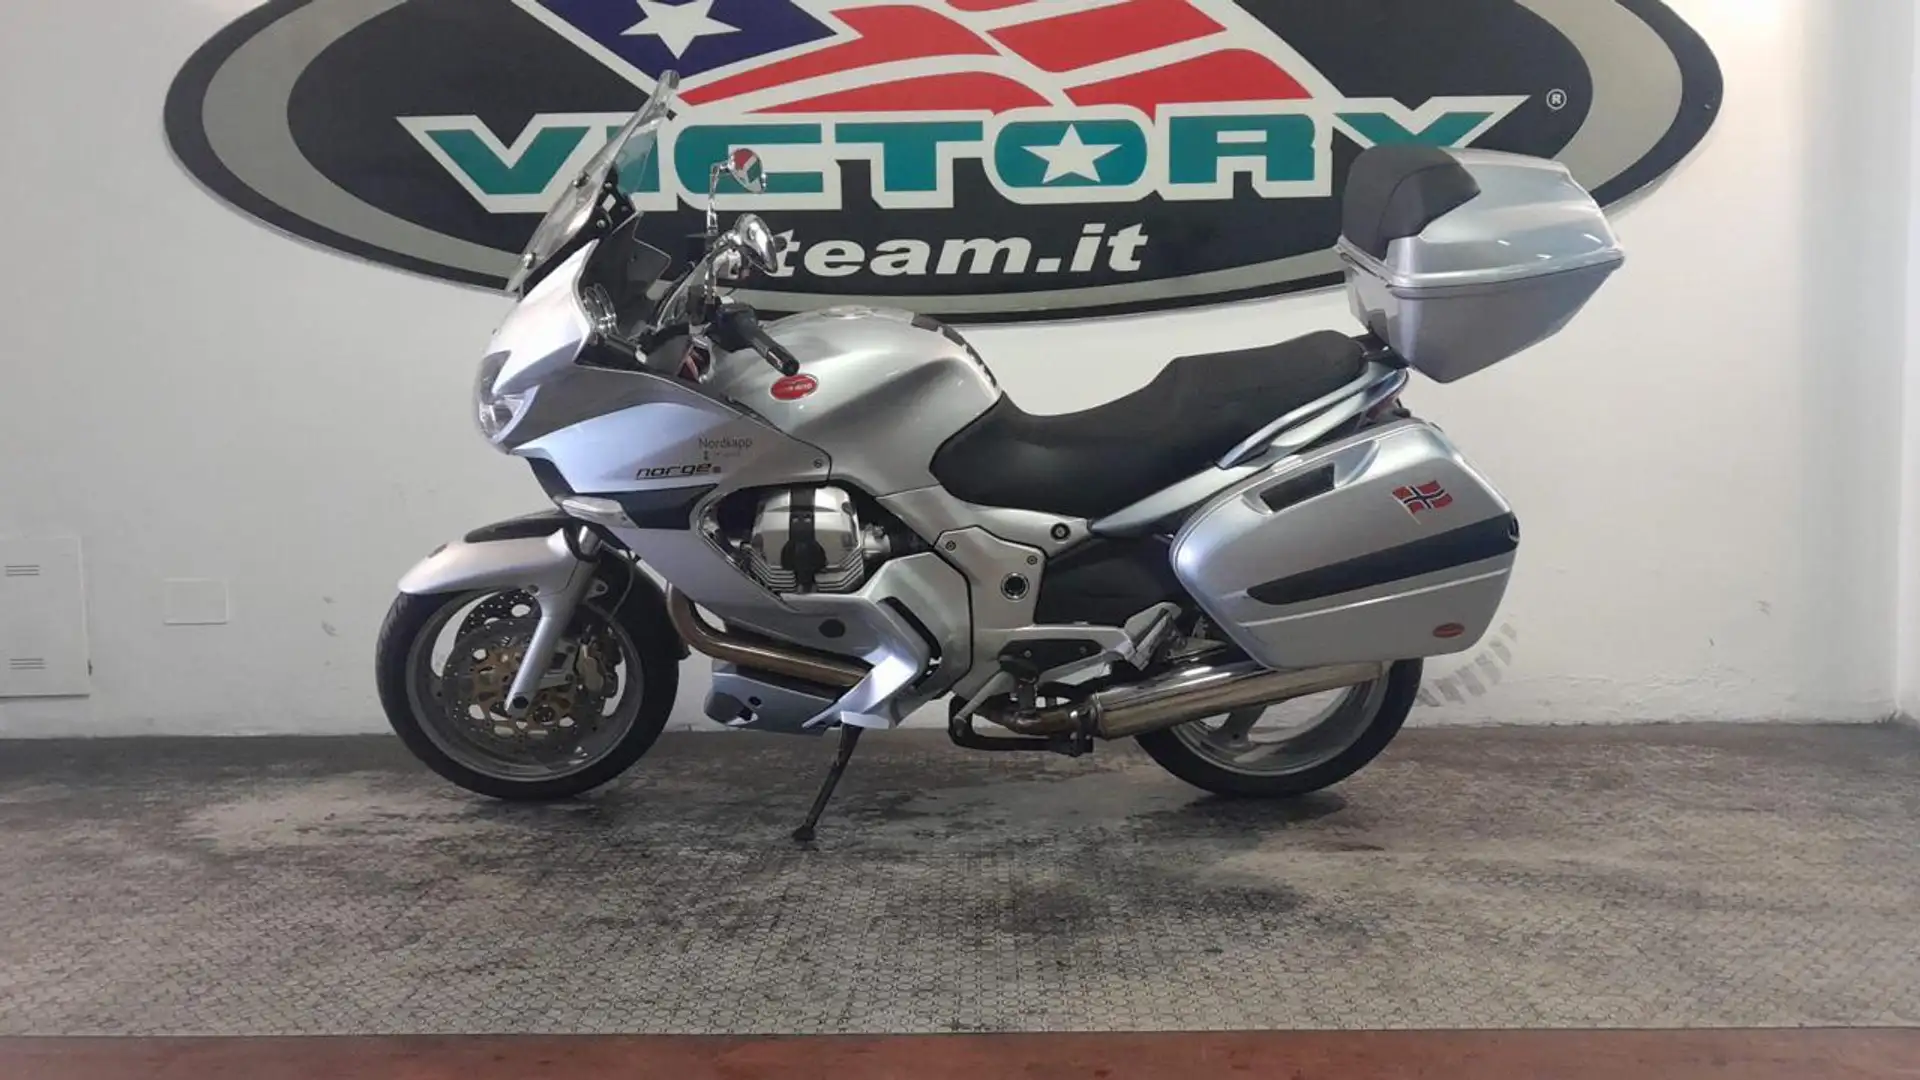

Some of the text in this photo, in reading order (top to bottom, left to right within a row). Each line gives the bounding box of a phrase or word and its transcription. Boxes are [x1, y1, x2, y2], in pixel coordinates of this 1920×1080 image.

[402, 98, 1522, 210] VICTORY
[772, 223, 1148, 278] team.it
[635, 463, 712, 480] norge
